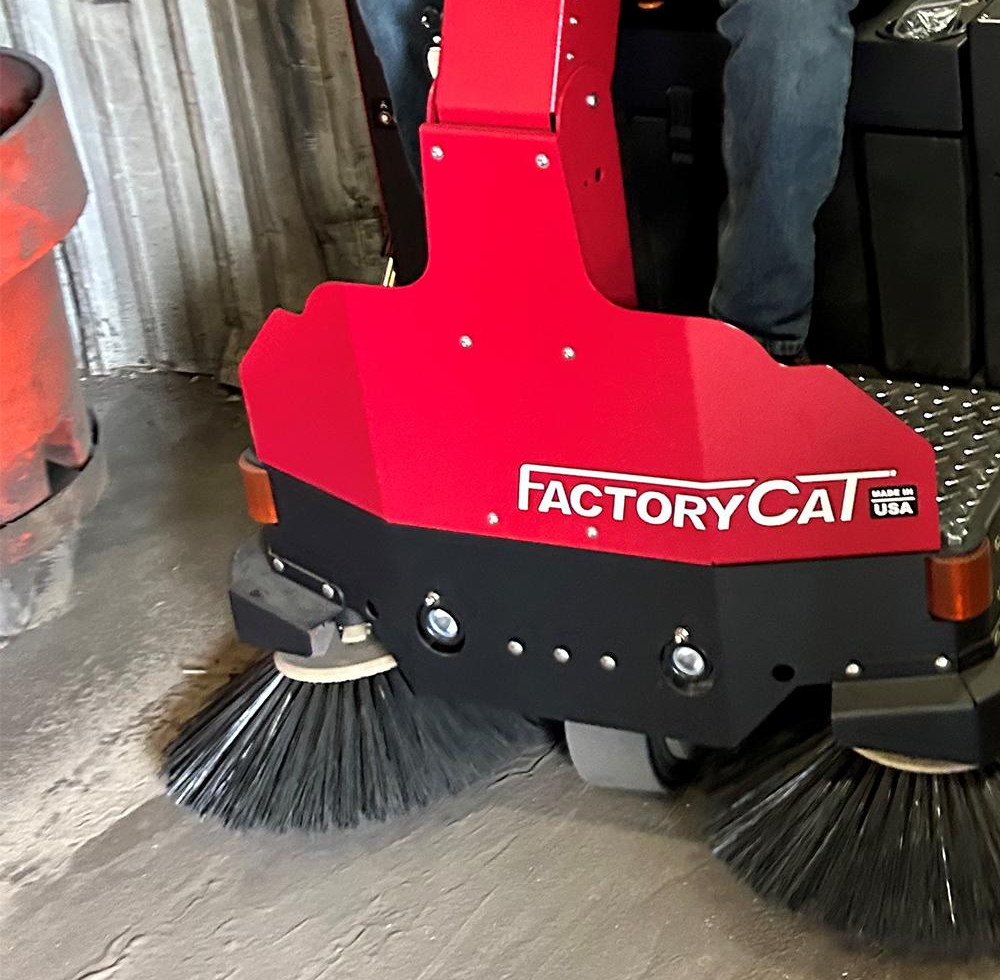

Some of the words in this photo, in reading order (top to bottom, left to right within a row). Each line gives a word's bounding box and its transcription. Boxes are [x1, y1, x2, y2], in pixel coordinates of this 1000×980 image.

[871, 488, 900, 498] MADE
[901, 487, 914, 496] IN
[873, 501, 914, 517] USA
